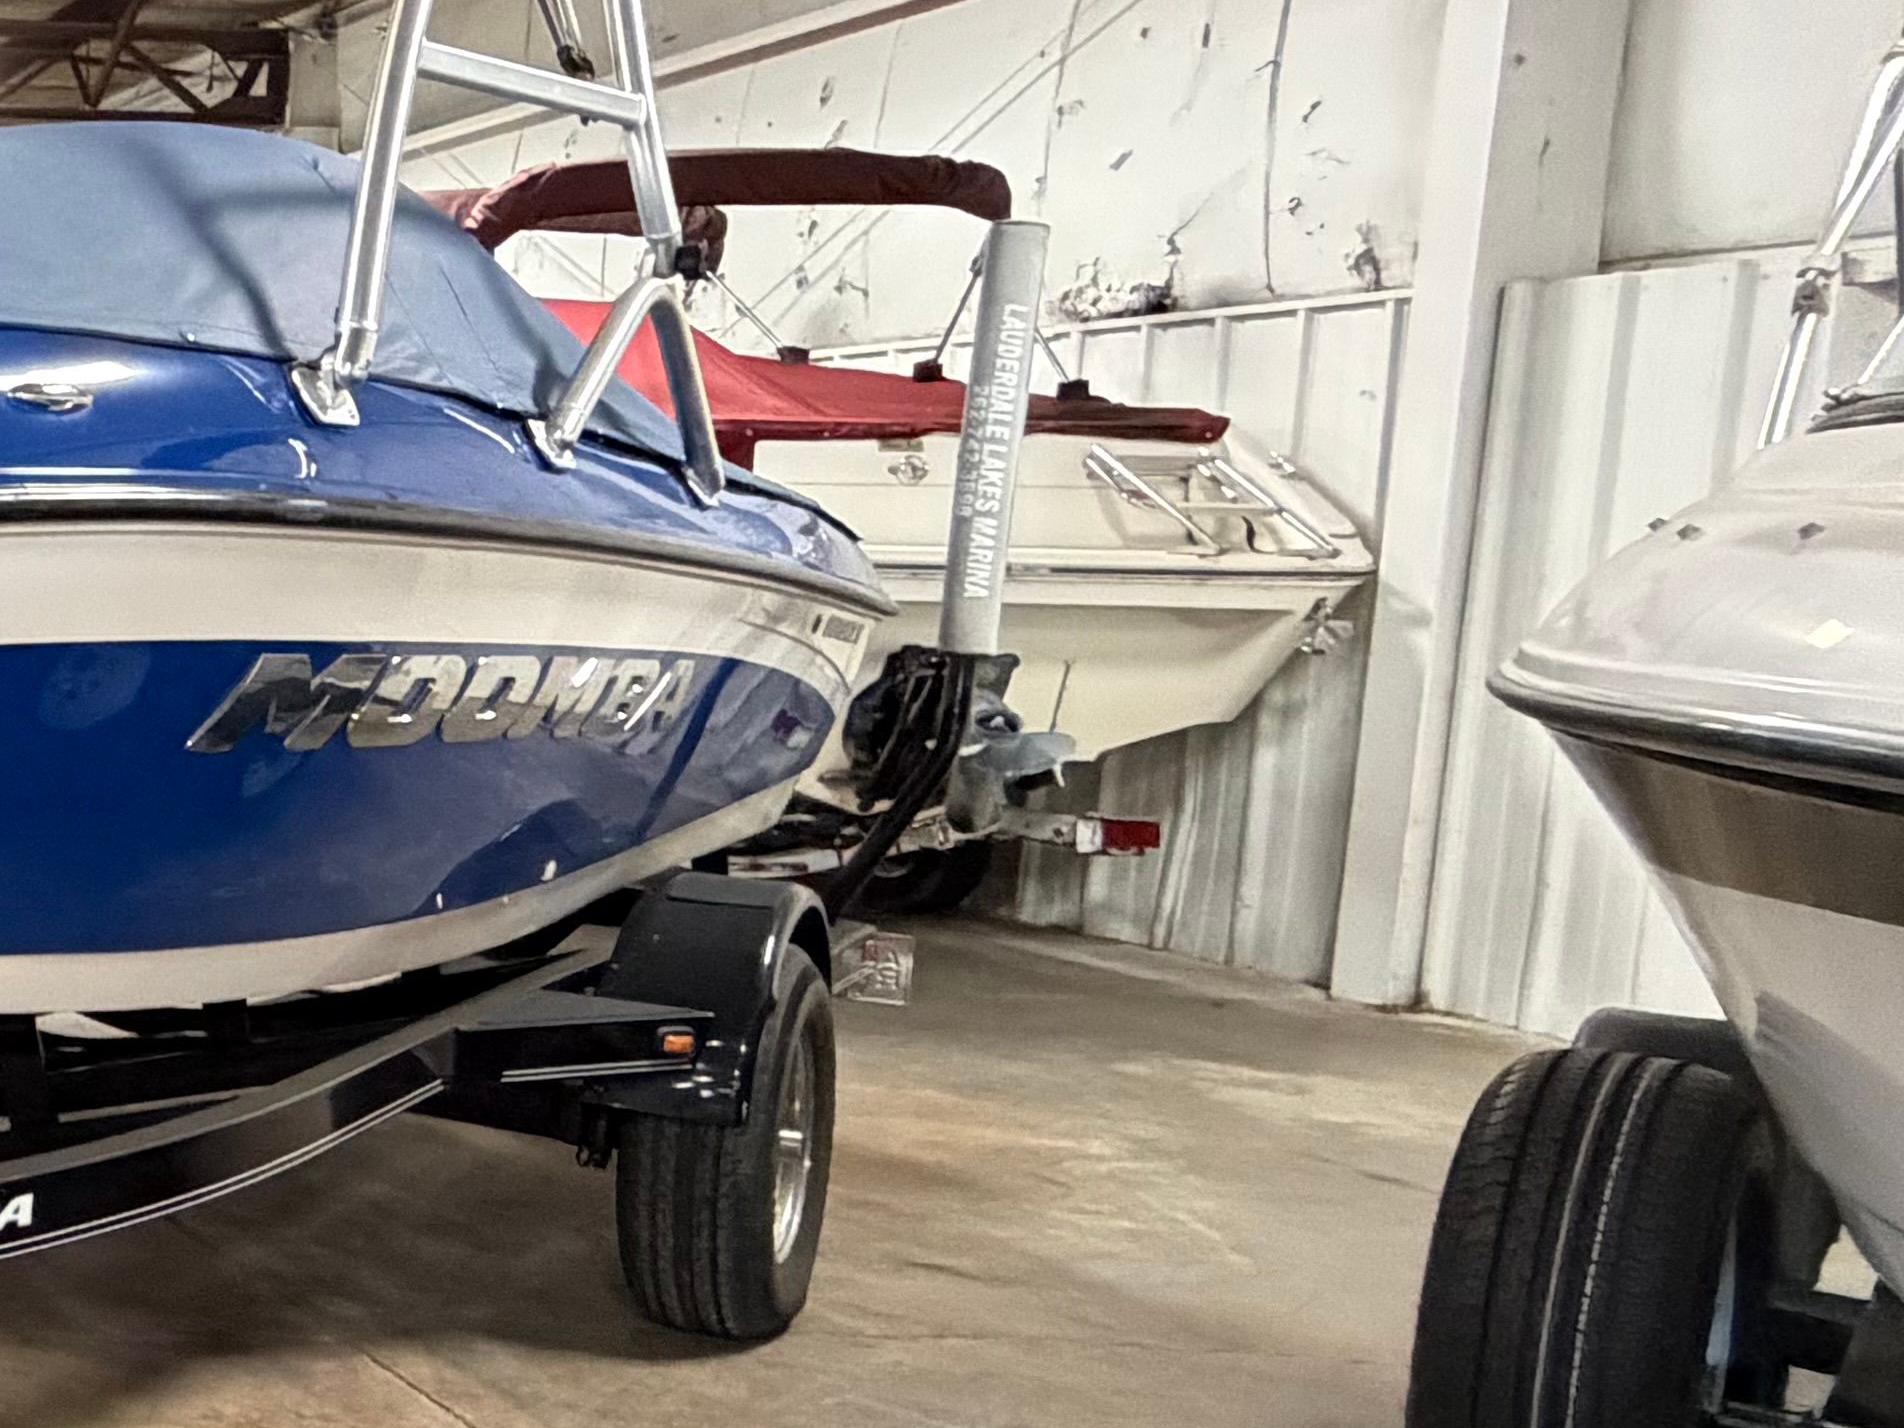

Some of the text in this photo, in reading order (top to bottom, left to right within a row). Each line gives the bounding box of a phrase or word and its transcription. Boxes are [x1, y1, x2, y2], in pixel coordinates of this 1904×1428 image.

[963, 303, 1028, 597] LAUDERDALE LAKES MARINA
[185, 653, 695, 755] MOOMBA
